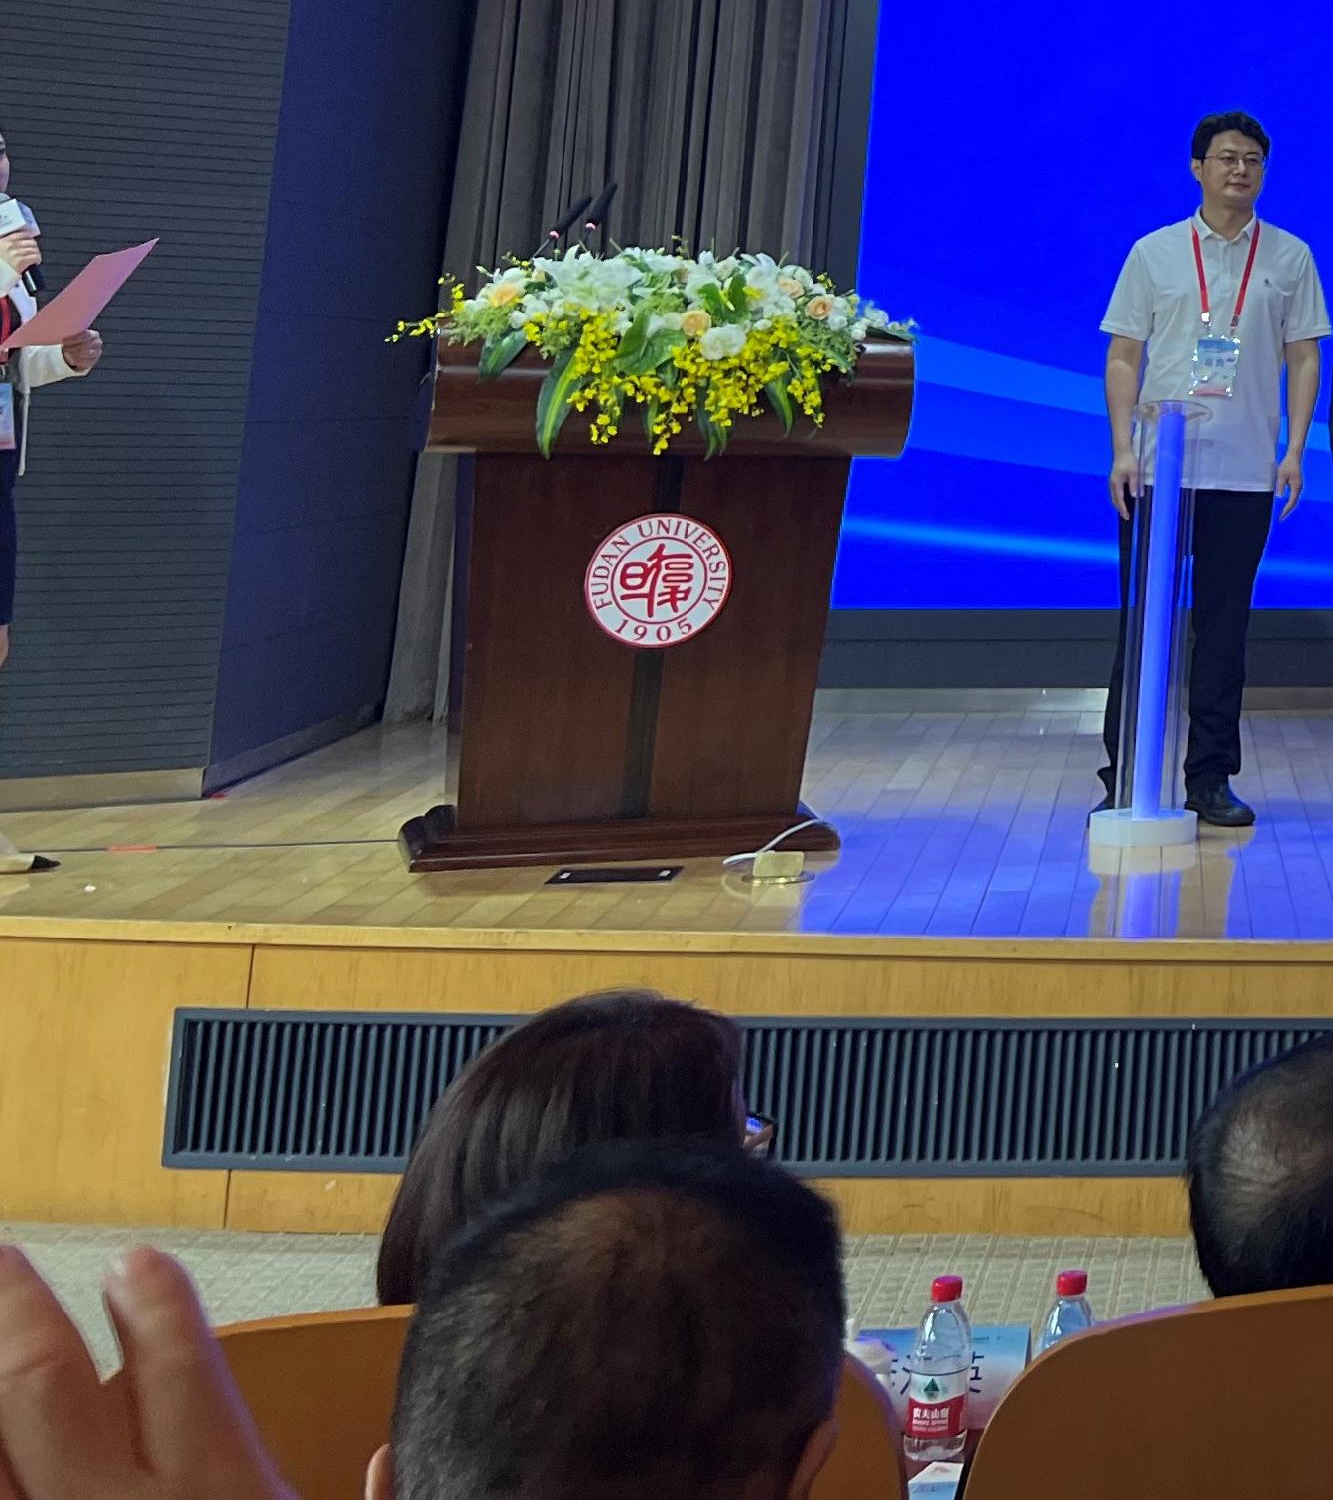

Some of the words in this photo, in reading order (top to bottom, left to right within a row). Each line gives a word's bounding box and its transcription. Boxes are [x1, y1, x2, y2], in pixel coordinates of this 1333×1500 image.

[591, 535, 631, 611] FUDAN
[637, 519, 727, 610] UNIVERSITY
[615, 619, 693, 642] 1905
